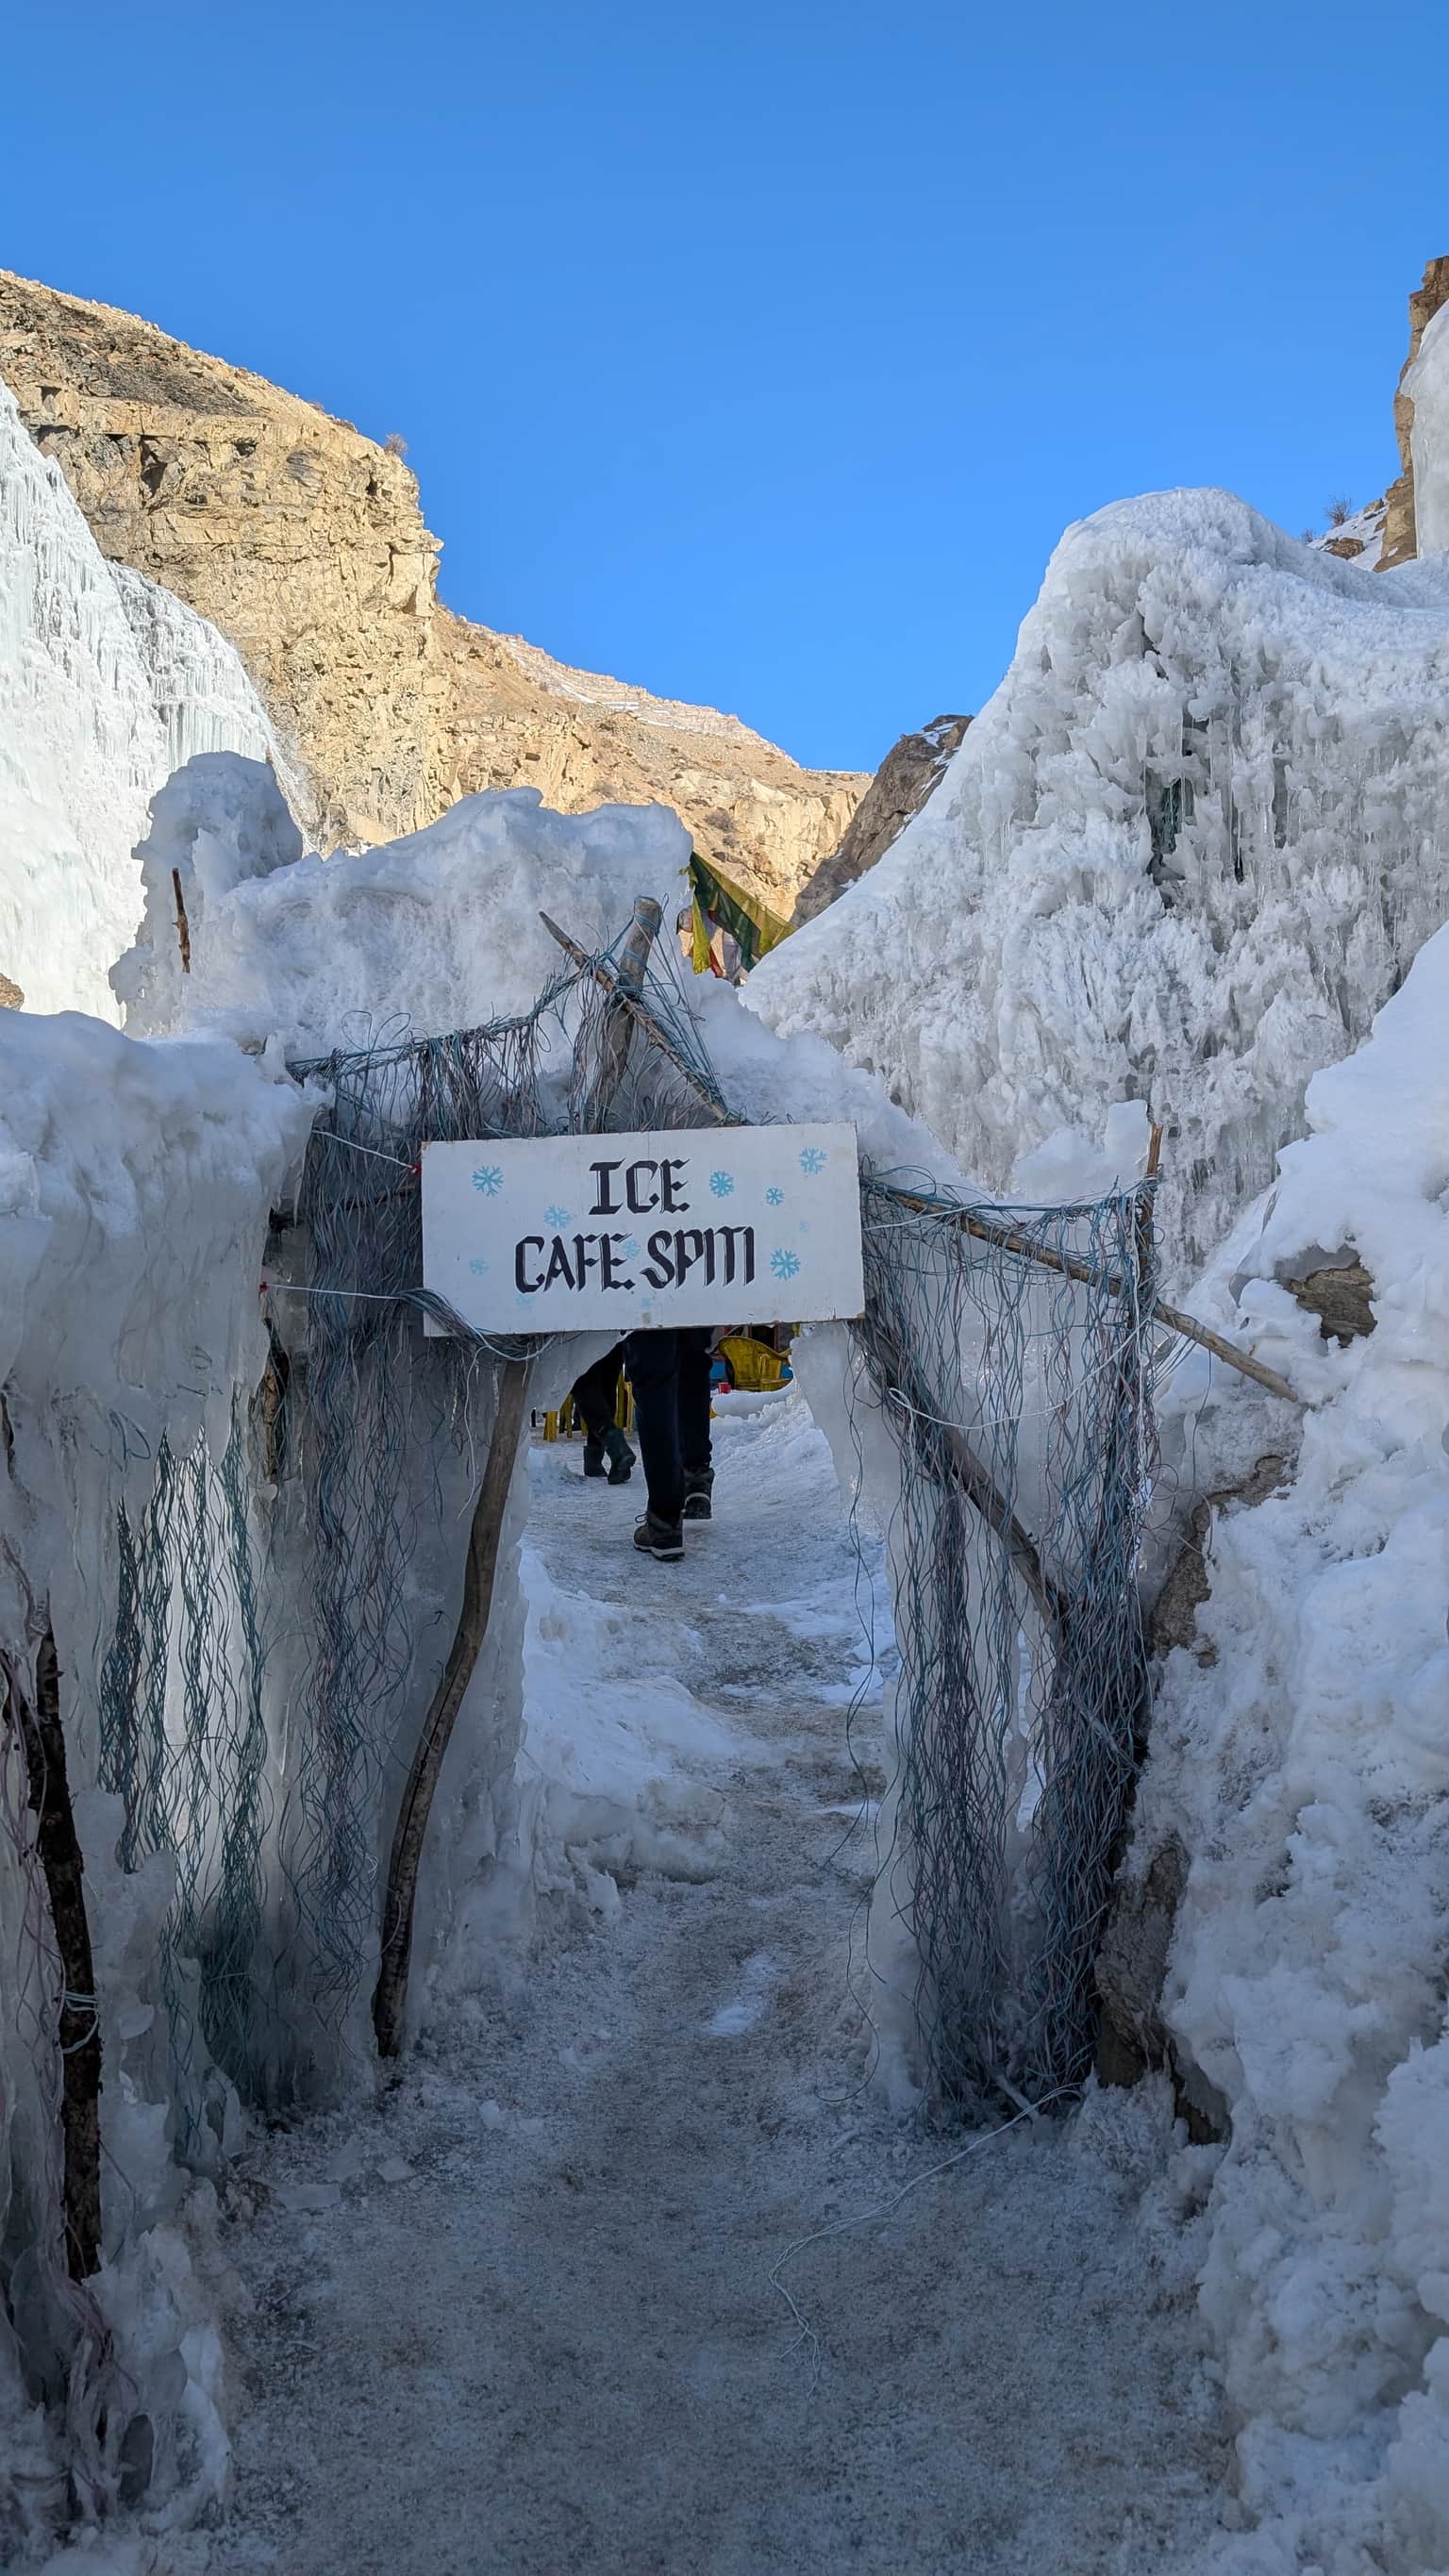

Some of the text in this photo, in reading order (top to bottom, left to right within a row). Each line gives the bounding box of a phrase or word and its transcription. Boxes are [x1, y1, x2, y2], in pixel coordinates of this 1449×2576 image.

[589, 1157, 691, 1215] ICE
[515, 1225, 755, 1293] CAFE SPITI
